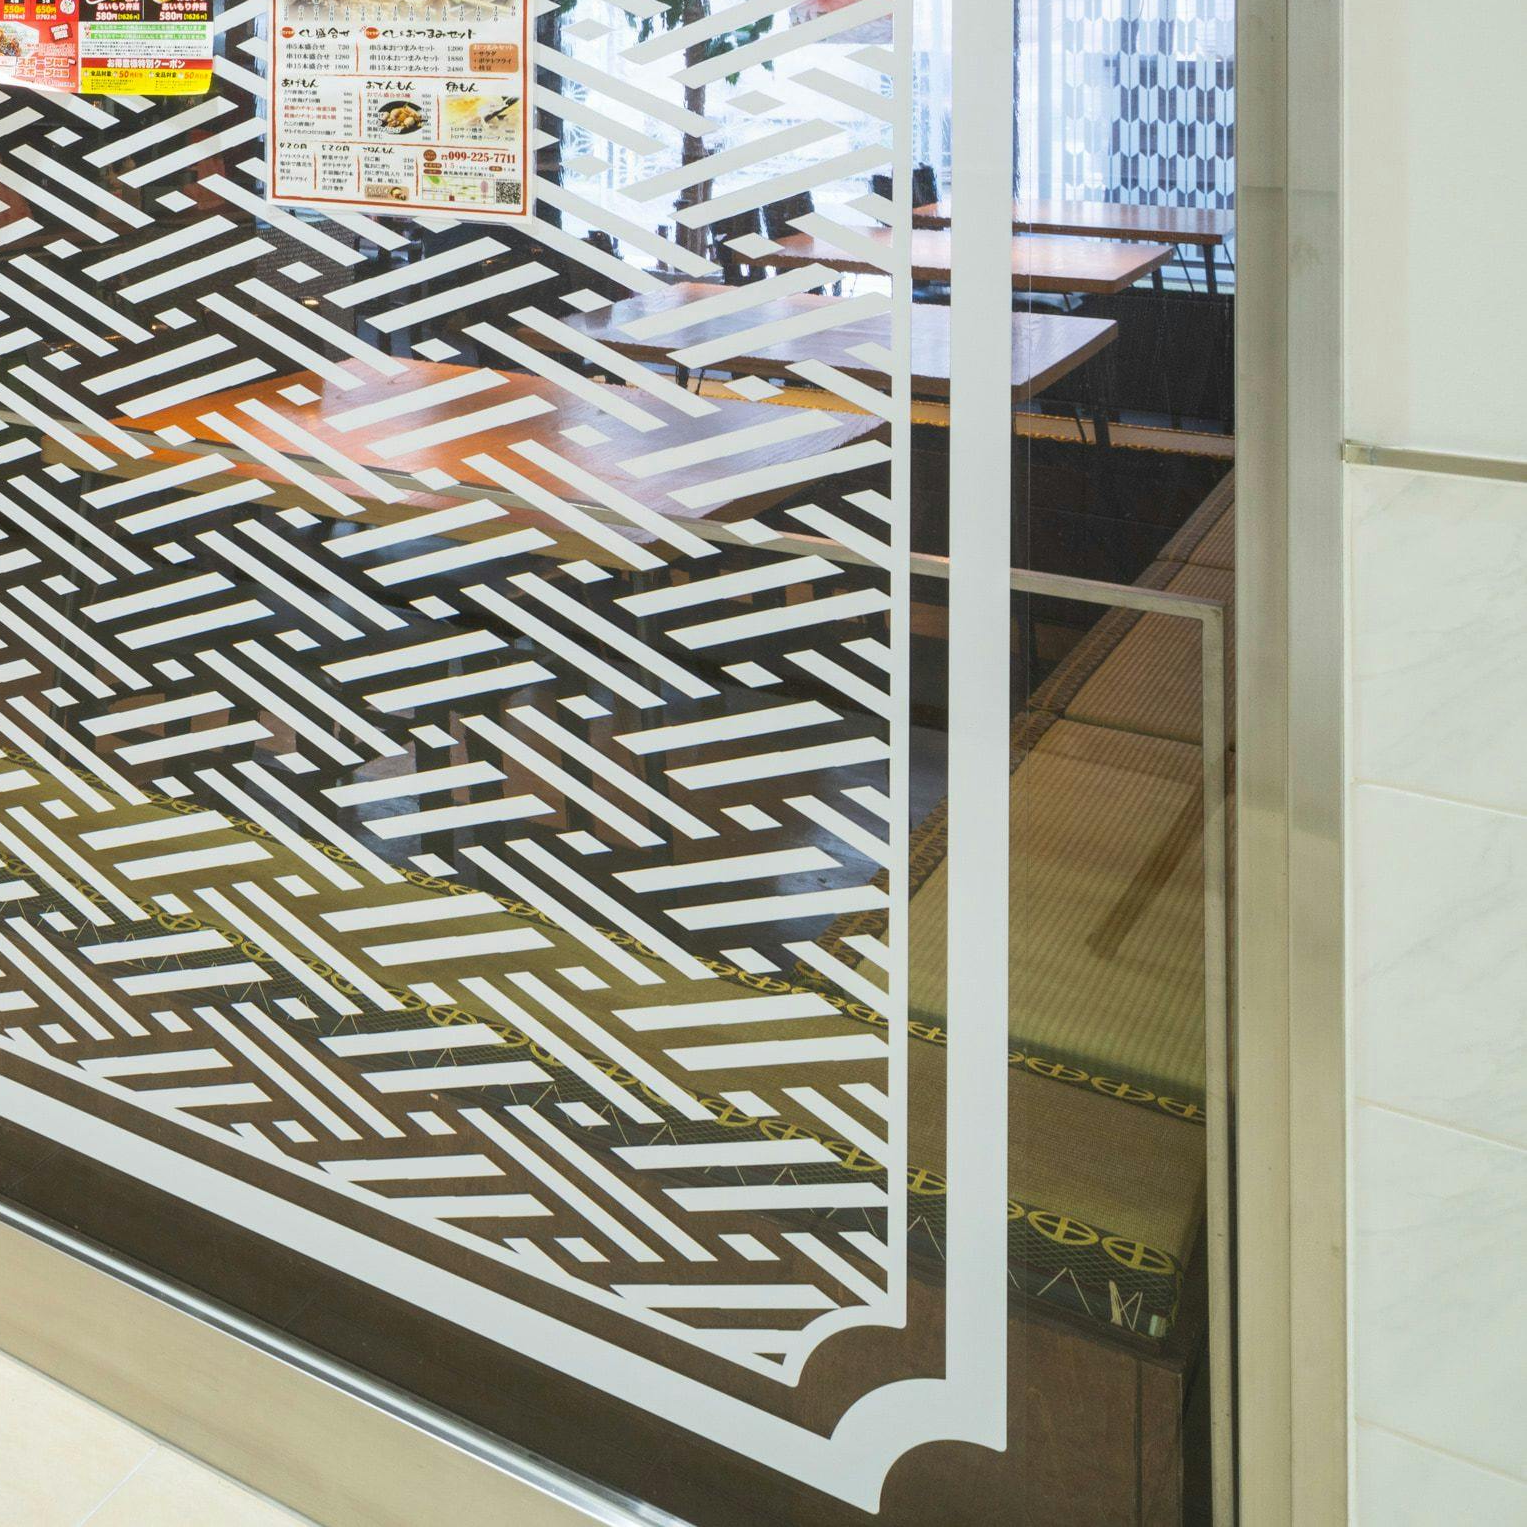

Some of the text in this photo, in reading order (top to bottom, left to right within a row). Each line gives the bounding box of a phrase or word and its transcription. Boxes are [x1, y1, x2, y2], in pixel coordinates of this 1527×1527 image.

[96, 12, 117, 20] 580円
[159, 12, 182, 20] 580円
[281, 78, 319, 88] あげもん
[365, 80, 416, 90] おでんもん
[448, 151, 516, 164] 099-225-7711
